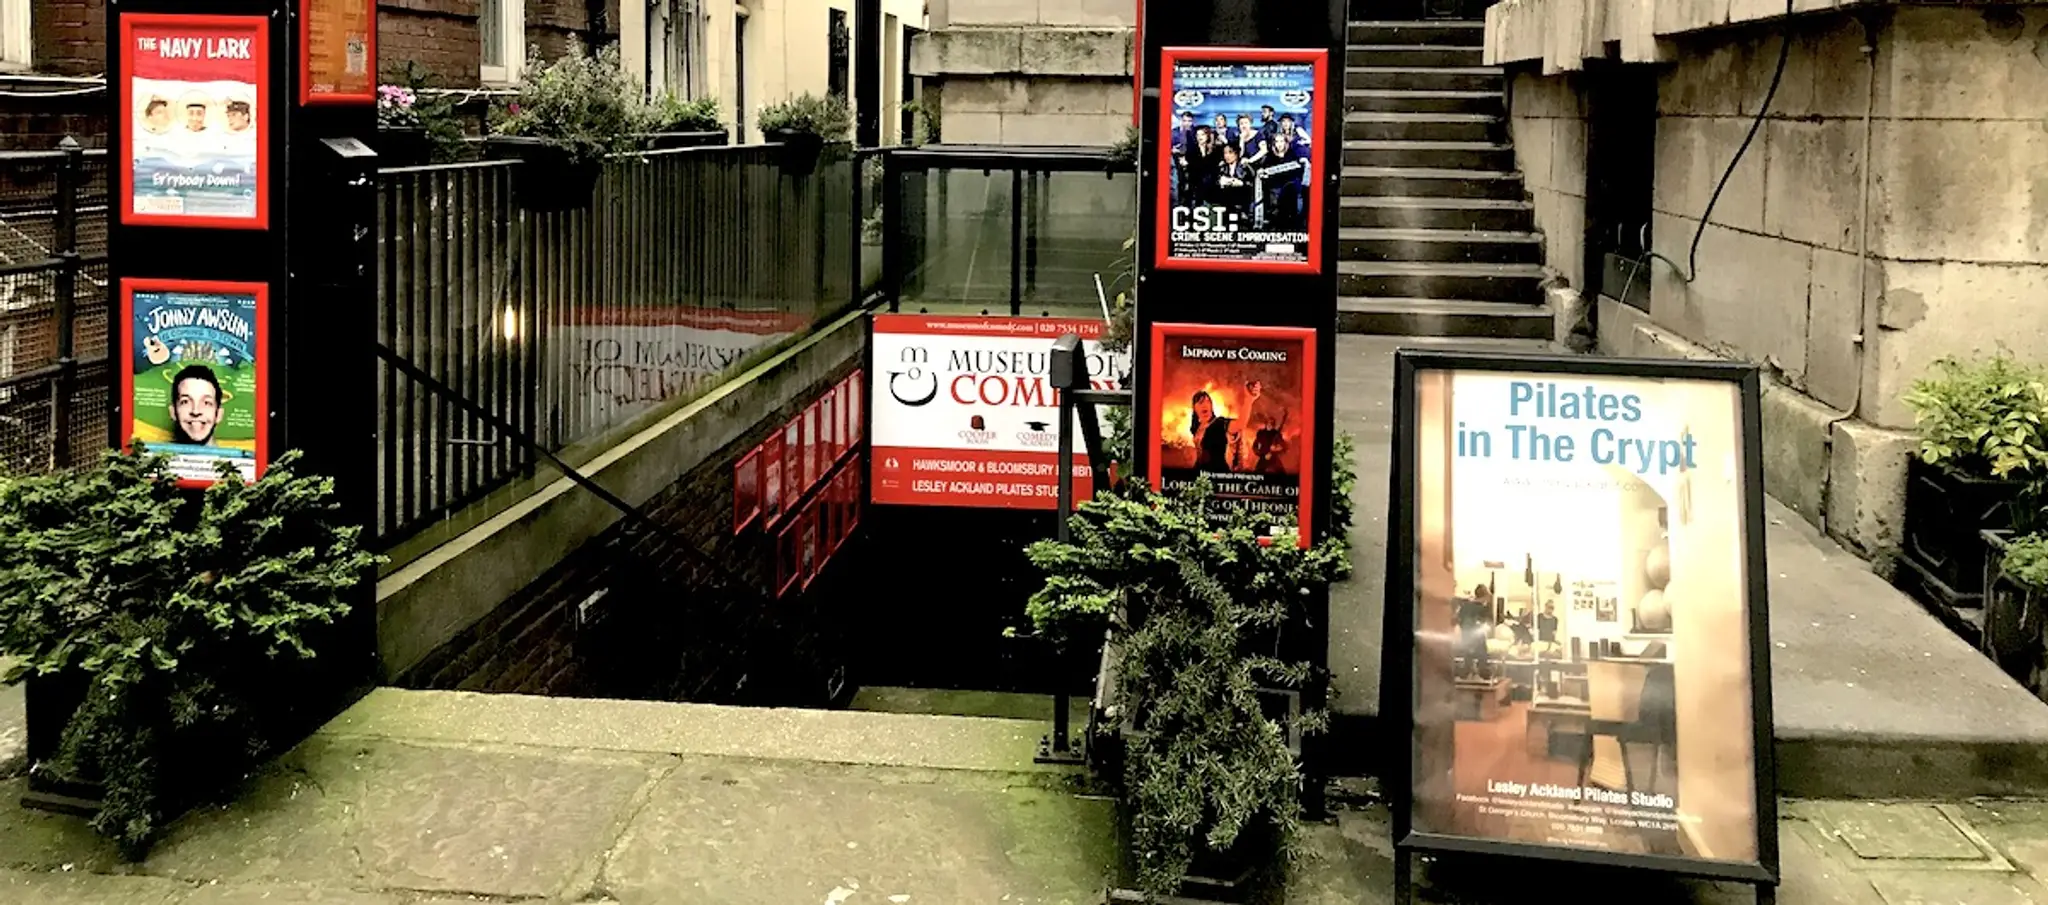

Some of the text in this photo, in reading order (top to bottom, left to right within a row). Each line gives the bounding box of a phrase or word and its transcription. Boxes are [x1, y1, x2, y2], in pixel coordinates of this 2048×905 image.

[137, 37, 251, 59] THE NAVY LARK
[1172, 206, 1239, 232] CSI:
[1171, 232, 1310, 243] CRIME SCENE IMPROVISATION
[148, 306, 249, 342] JONNY AWSUM
[947, 350, 1051, 375] MUSEU
[1510, 382, 1642, 423] Pilates
[1458, 421, 1697, 475] in The Crypt
[912, 459, 976, 474] HAWKSMOOR
[978, 461, 985, 473] &
[986, 461, 1054, 477] BLOOMSBURY
[912, 480, 947, 493] LESLEY
[949, 482, 994, 495] ACKLAND
[996, 483, 1034, 497] PILATES
[1488, 779, 1674, 809] Lesley Ackland Pilates Studio
